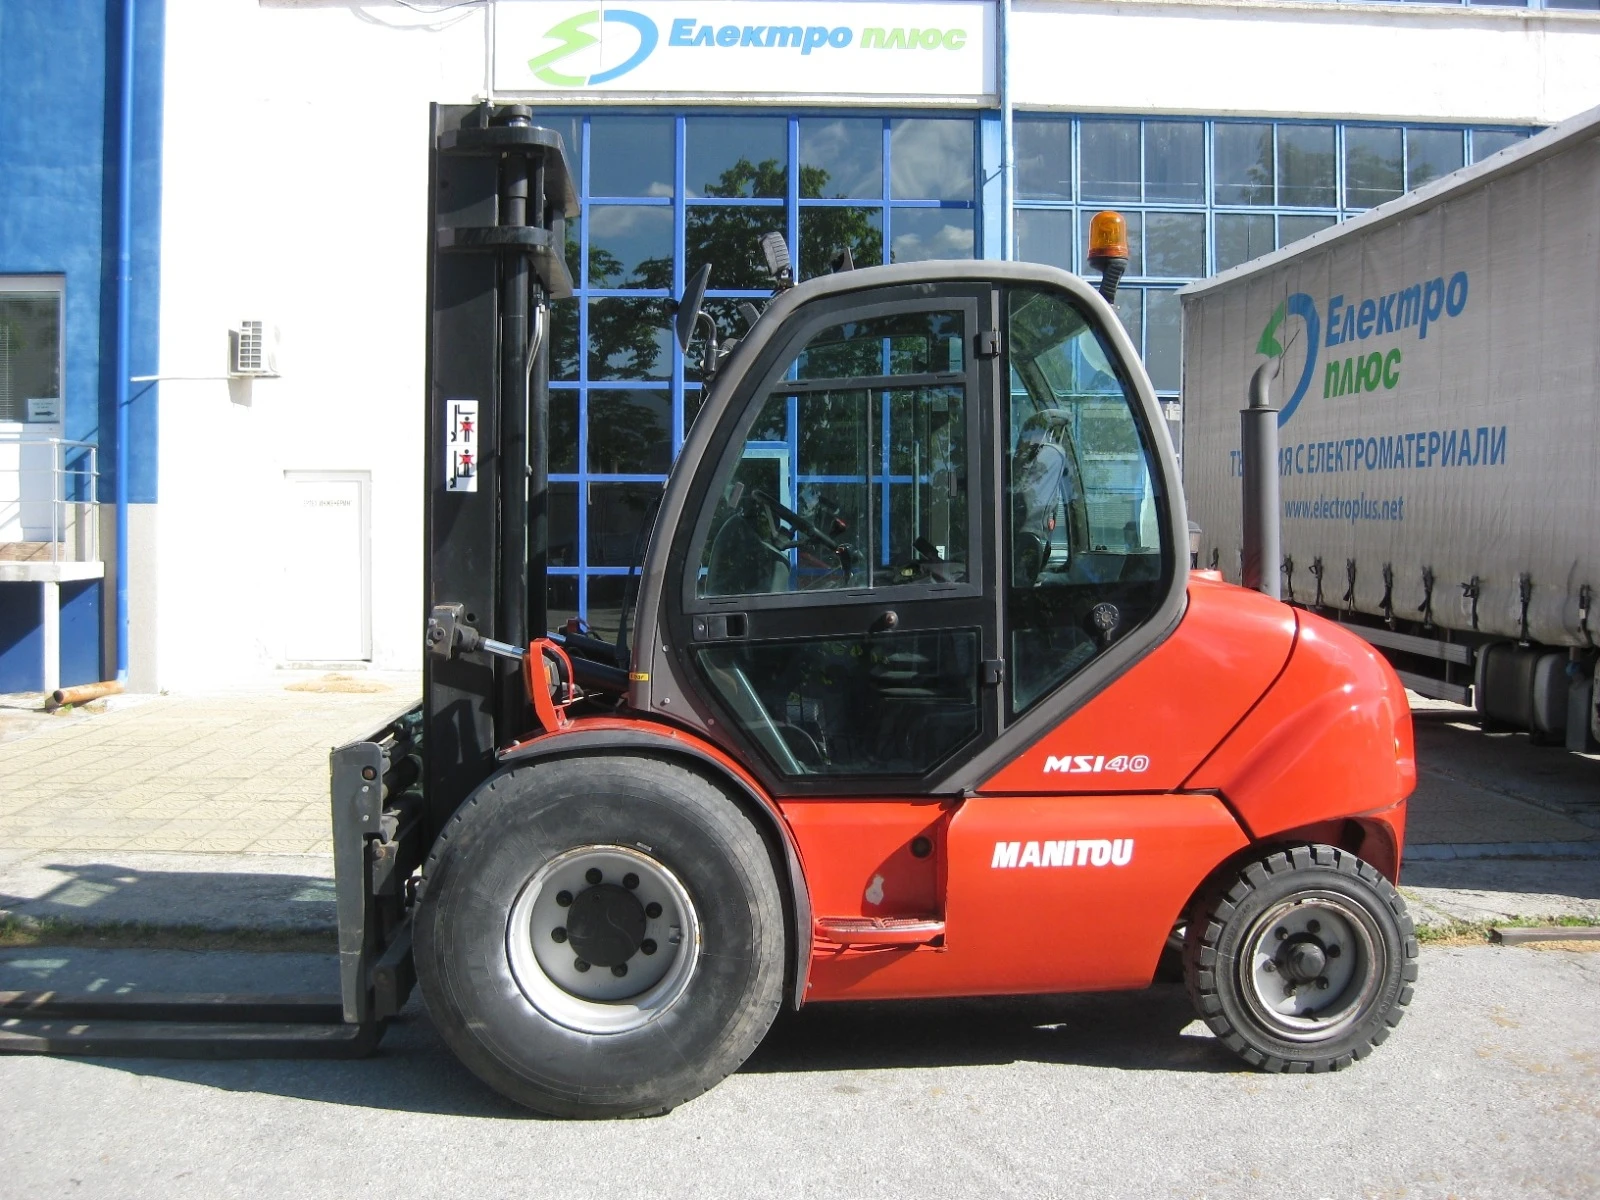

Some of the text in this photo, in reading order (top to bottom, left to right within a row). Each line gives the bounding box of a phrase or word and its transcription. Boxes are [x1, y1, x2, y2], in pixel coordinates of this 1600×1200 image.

[667, 17, 968, 56] Електро плюс
[1324, 270, 1470, 349] Електро
[1323, 347, 1404, 400] плюс
[1295, 443, 1306, 475] С
[1306, 425, 1508, 475] ЕЛЕКТРОМАТЕРИАЛИ
[1284, 492, 1405, 525] www.electroplus.net
[1042, 754, 1150, 774] MSI40
[990, 838, 1135, 870] MANITOU
